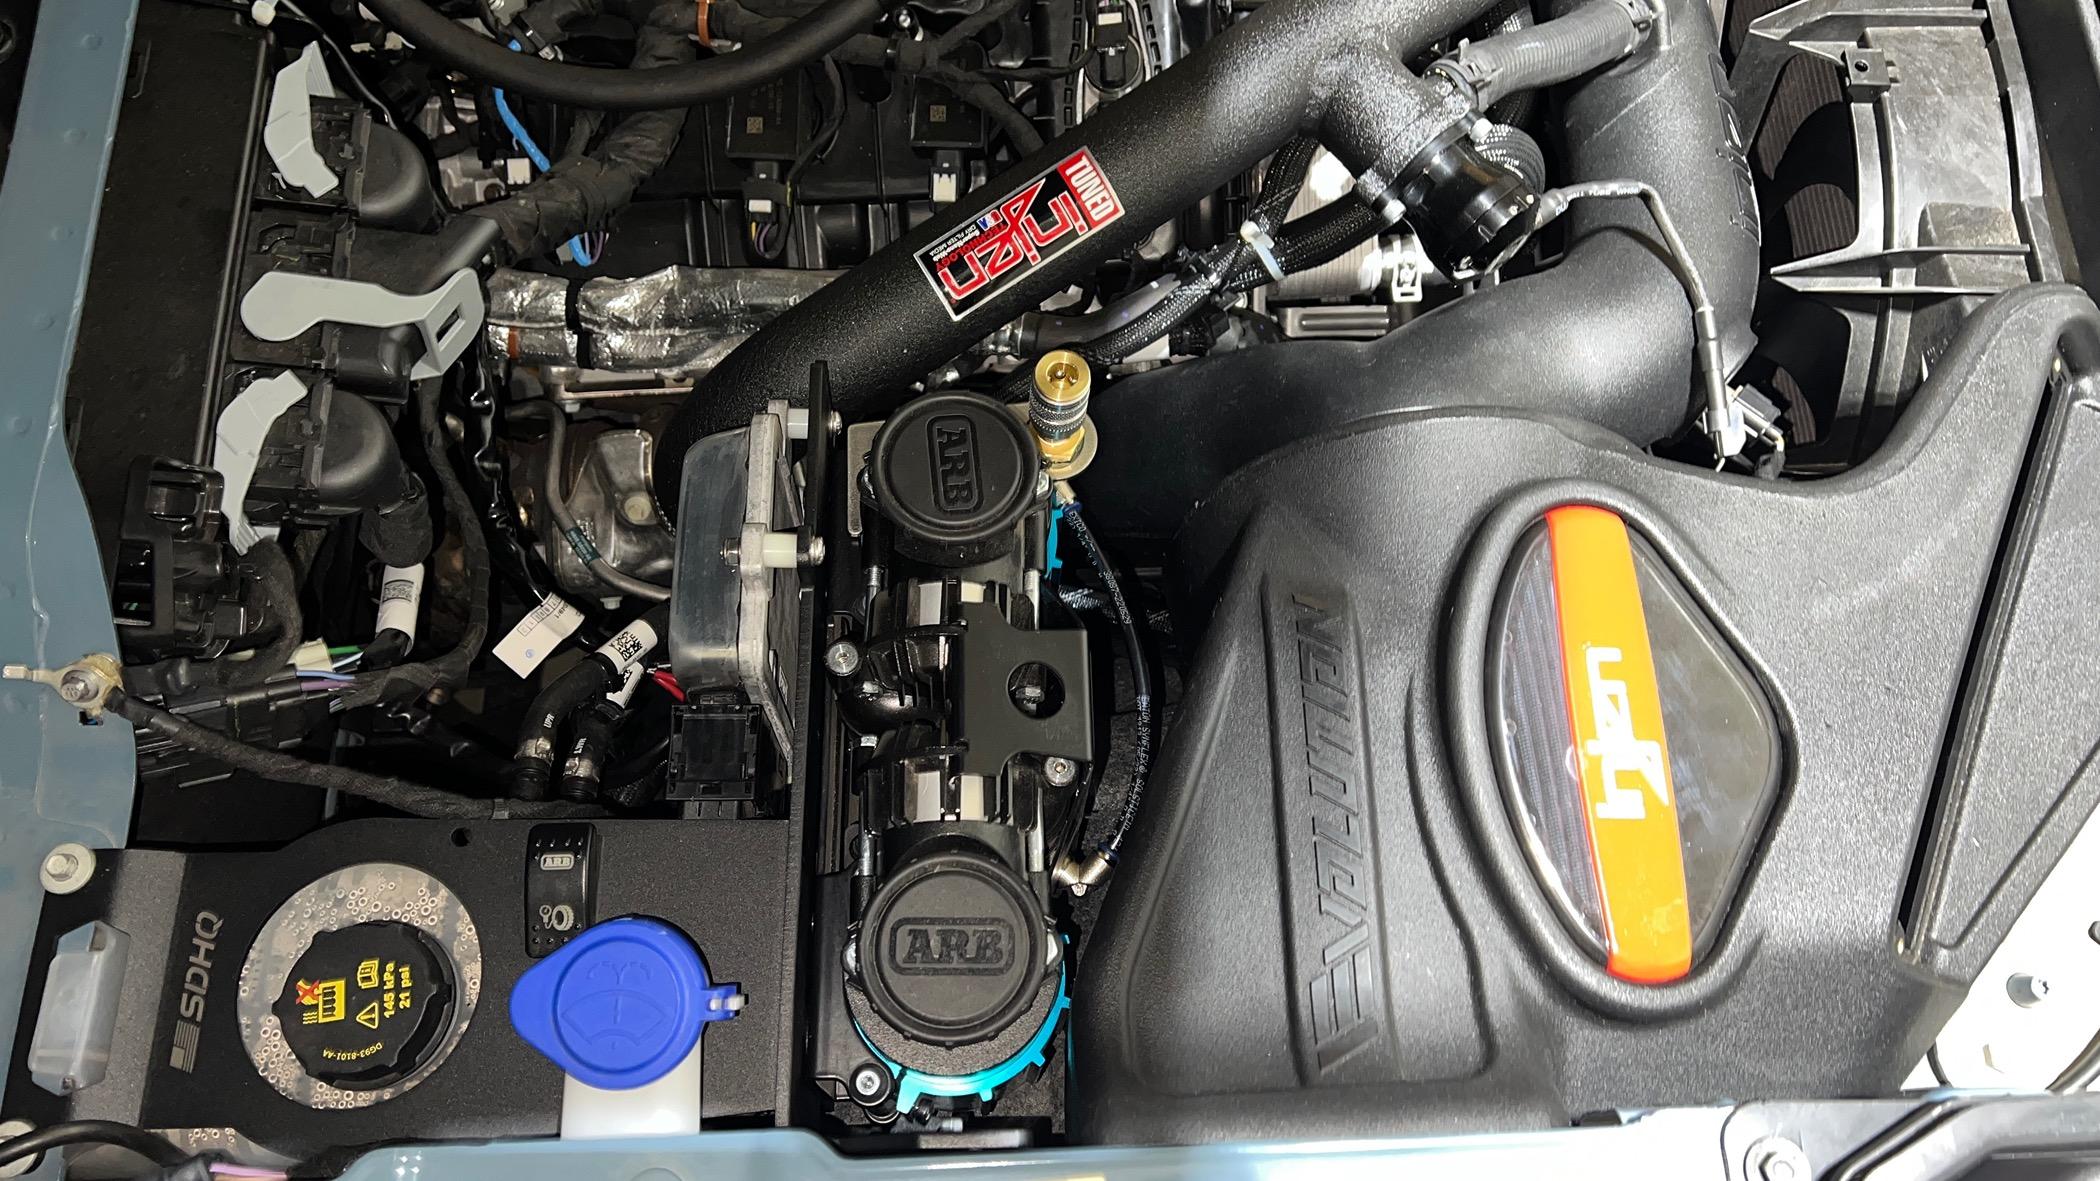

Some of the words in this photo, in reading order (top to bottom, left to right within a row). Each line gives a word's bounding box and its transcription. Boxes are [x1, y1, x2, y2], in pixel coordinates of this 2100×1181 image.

[1065, 155, 1115, 222] TUNED
[935, 221, 1008, 272] TECHNOLOGY
[937, 177, 1089, 301] injen
[936, 426, 973, 503] ARB
[543, 713, 555, 728] UPR
[1141, 695, 1150, 723] EATON
[573, 738, 587, 754] LWR
[543, 856, 571, 867] ARB
[902, 928, 1003, 964] ARB
[179, 910, 224, 1023] SDHQ
[383, 961, 396, 990] kPa
[398, 966, 413, 988] psi
[383, 991, 396, 1018] 145
[398, 991, 411, 1010] 21
[322, 1041, 384, 1061] DG93-8101-AA
